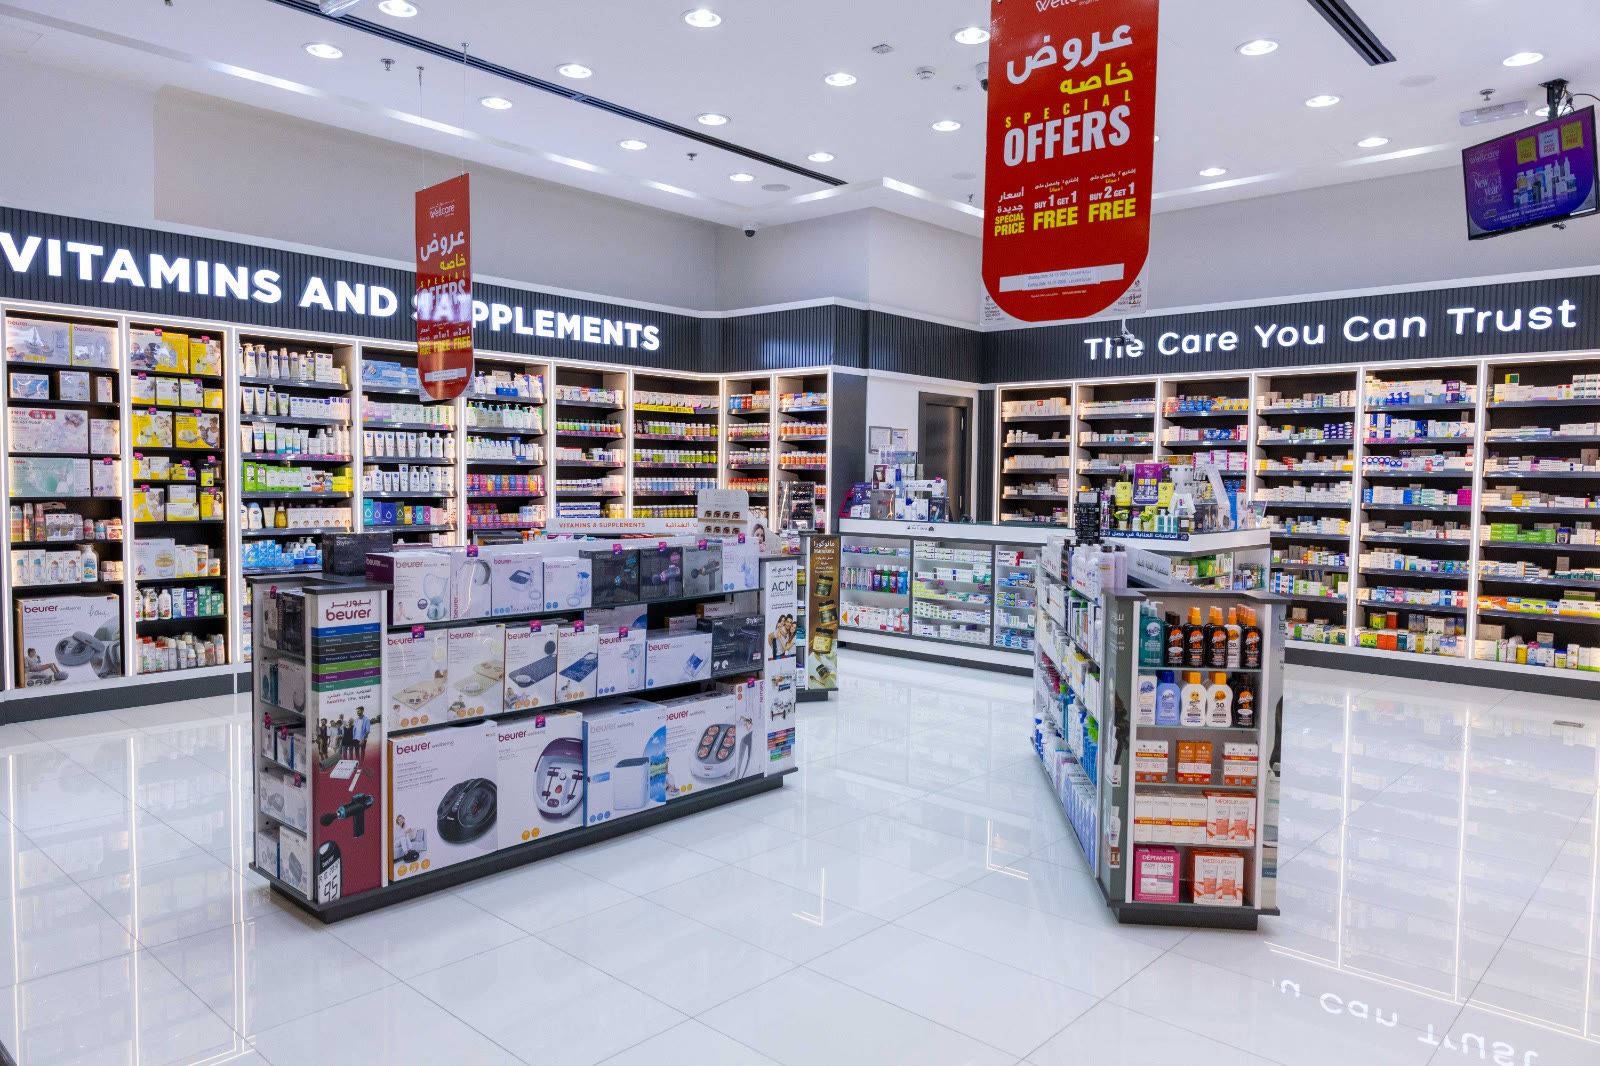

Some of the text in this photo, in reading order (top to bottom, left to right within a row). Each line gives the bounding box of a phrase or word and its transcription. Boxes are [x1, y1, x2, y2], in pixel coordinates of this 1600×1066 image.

[1006, 24, 1133, 85] عروض
[1059, 62, 1134, 95] خاصه
[1005, 89, 1131, 128] SPECIAL
[1003, 104, 1131, 167] OFFERS
[998, 186, 1025, 203] أسعار
[1089, 181, 1135, 201] BUY 2 GET 1
[1034, 190, 1077, 210] BUY 1 GET 1
[1088, 197, 1137, 223] FREE
[994, 212, 1025, 225] SPECIAL
[1033, 206, 1079, 231] FREE
[994, 221, 1025, 237] PRICE
[420, 229, 465, 262] عروض
[439, 253, 466, 271] خاصه
[420, 272, 466, 288] SPECIAL
[0, 231, 660, 351] VITAMINS AND PPLEMENTS
[1083, 298, 1577, 361] The Care You Can Trust
[433, 339, 451, 353] FREE
[453, 336, 471, 350] FREE
[366, 557, 381, 567] beurer
[395, 560, 424, 569] beurer
[771, 580, 794, 592] ACM
[24, 604, 58, 613] beurer
[326, 609, 372, 621] beurer
[387, 636, 416, 646] beurer
[449, 631, 475, 640] beurer
[507, 631, 532, 640] beurer
[599, 635, 622, 645] beurer
[648, 643, 671, 652] beurer
[666, 710, 689, 721] eurer
[590, 723, 617, 734] beurer
[498, 730, 527, 742] beurer
[396, 741, 431, 755] beurer
